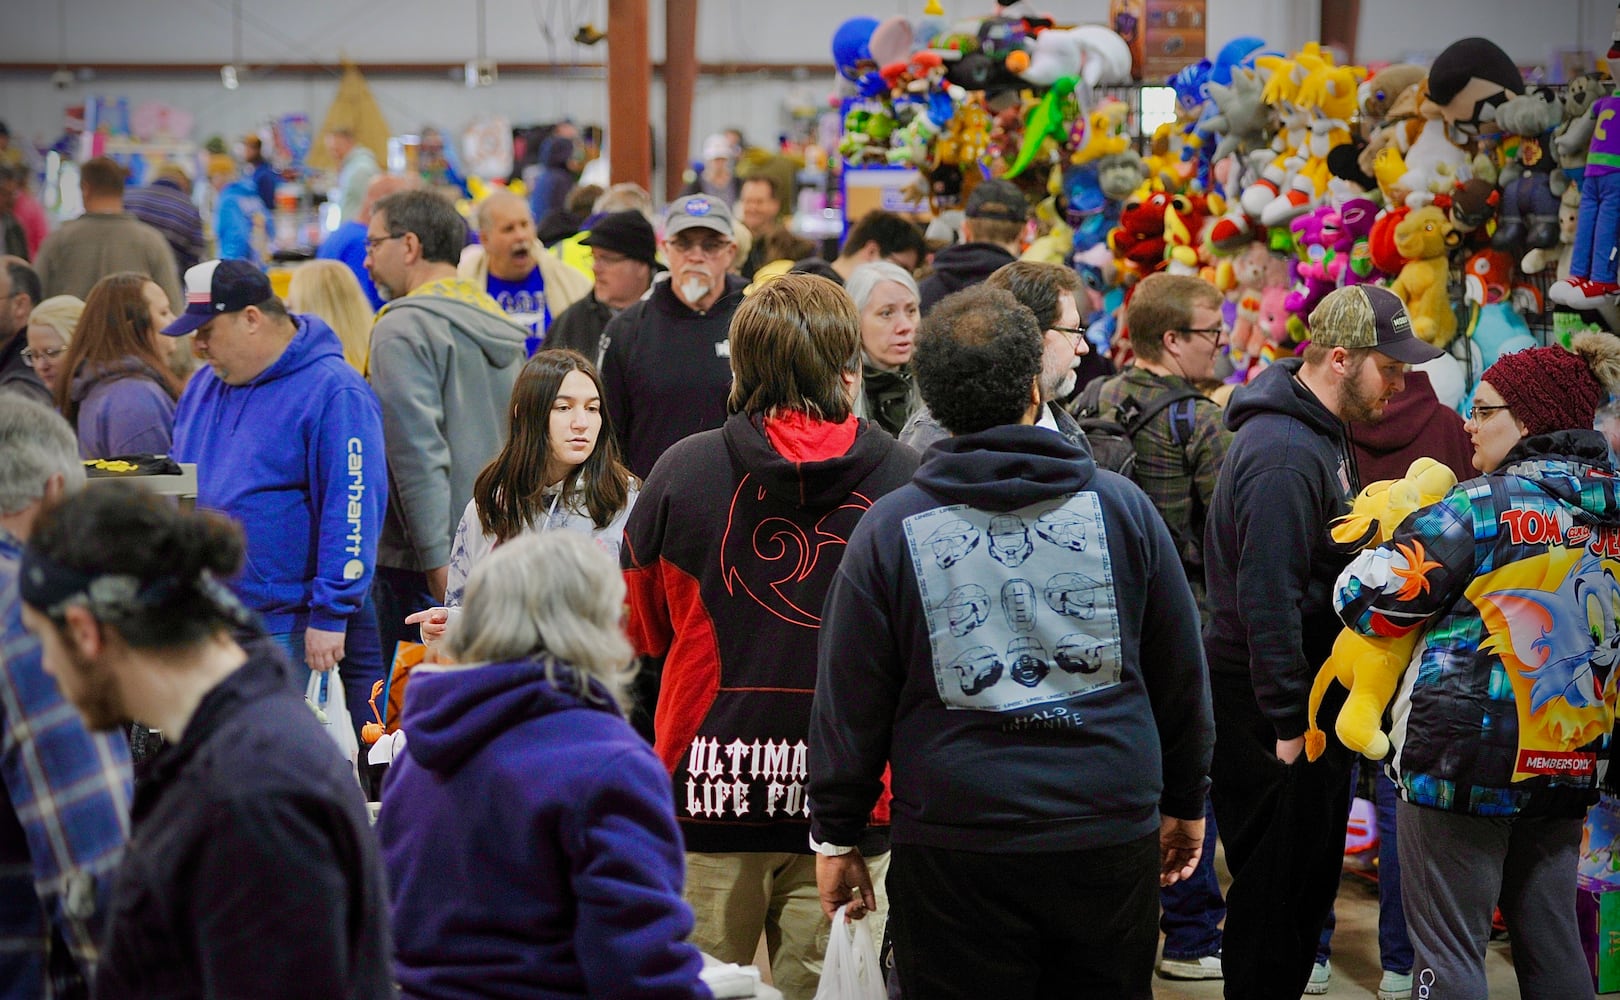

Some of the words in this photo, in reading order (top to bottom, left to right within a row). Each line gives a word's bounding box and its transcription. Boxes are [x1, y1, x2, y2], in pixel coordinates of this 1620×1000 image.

[345, 437, 365, 557] carhartt
[1500, 509, 1563, 545] TOM
[1591, 526, 1620, 558] JE
[1002, 713, 1083, 732] INFINITE
[1014, 707, 1067, 724] HALO
[687, 735, 808, 780] ULTIMA
[685, 776, 750, 818] LIFE
[1419, 967, 1435, 1000] Ca
